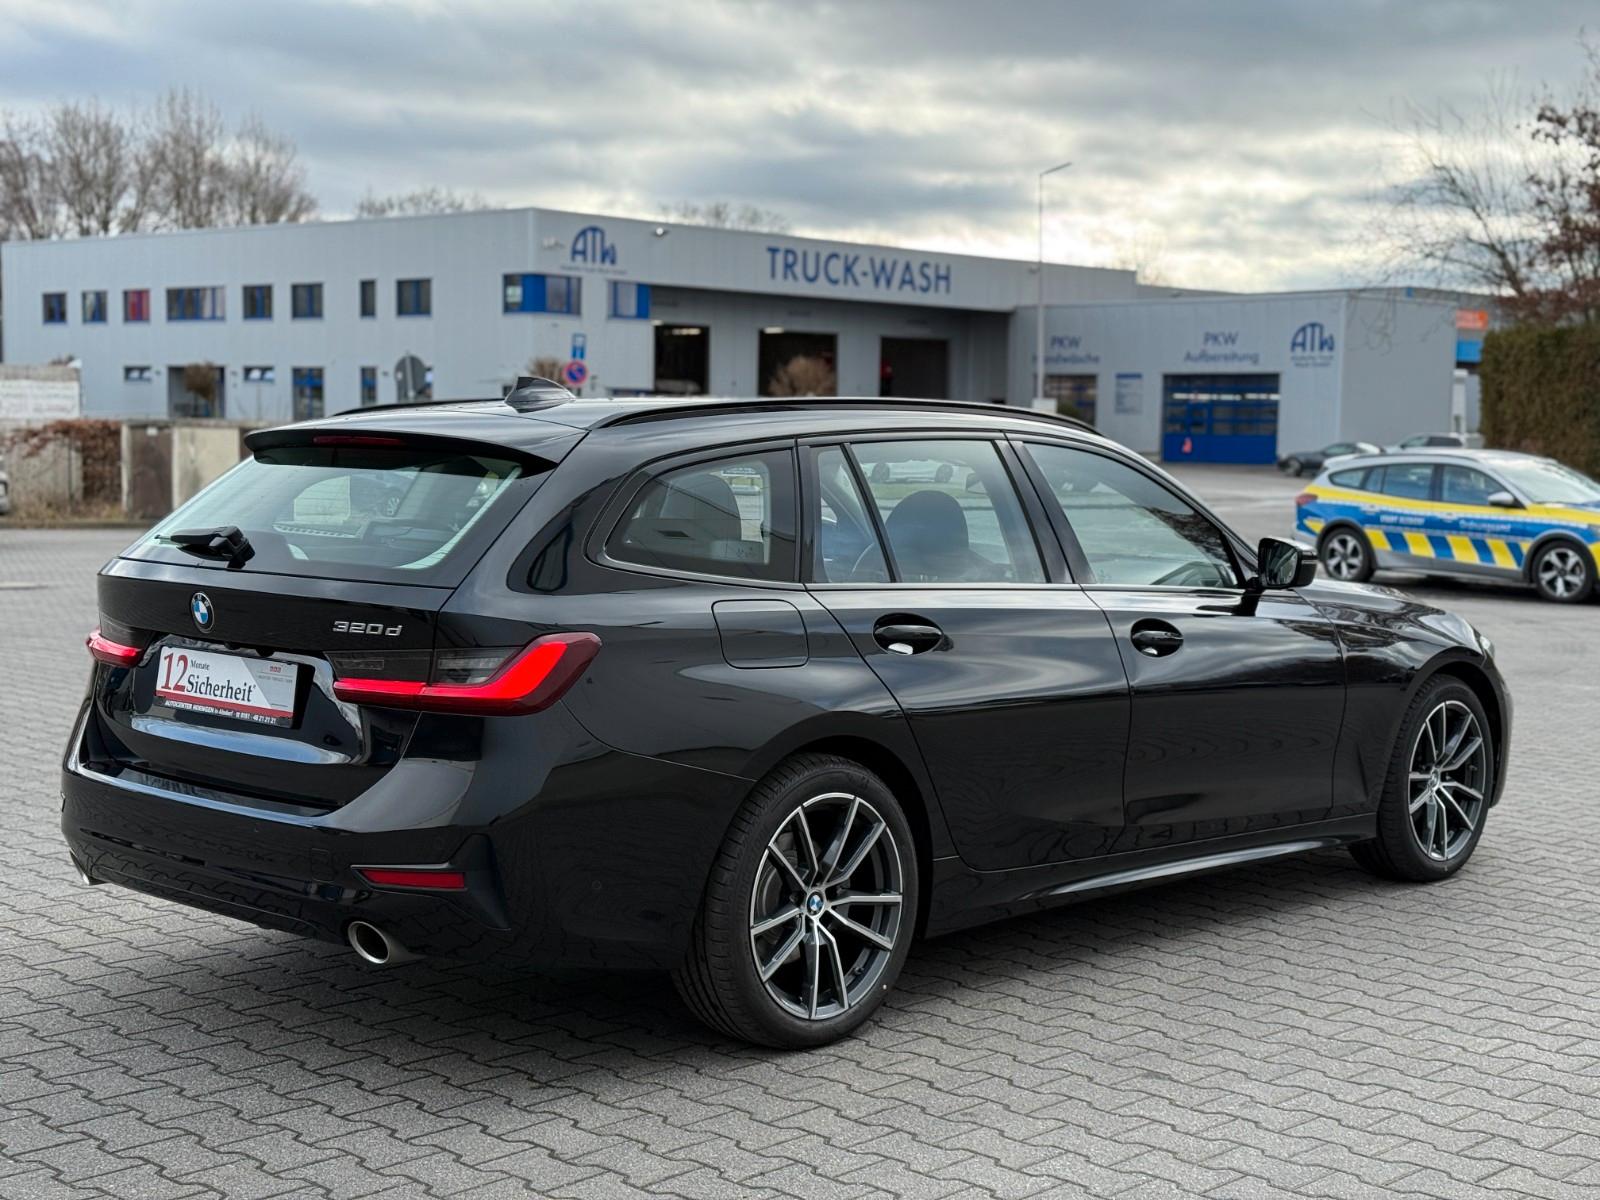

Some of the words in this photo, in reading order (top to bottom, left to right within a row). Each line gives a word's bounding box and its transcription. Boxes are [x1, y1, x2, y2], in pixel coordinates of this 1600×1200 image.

[766, 245, 952, 295] TRUCK-WASH
[1050, 335, 1082, 349] PKW
[1203, 331, 1239, 347] PKW
[1183, 349, 1260, 366] Aufbereitung
[332, 620, 403, 637] 320d
[161, 652, 189, 692] 12
[190, 659, 210, 671] Monate
